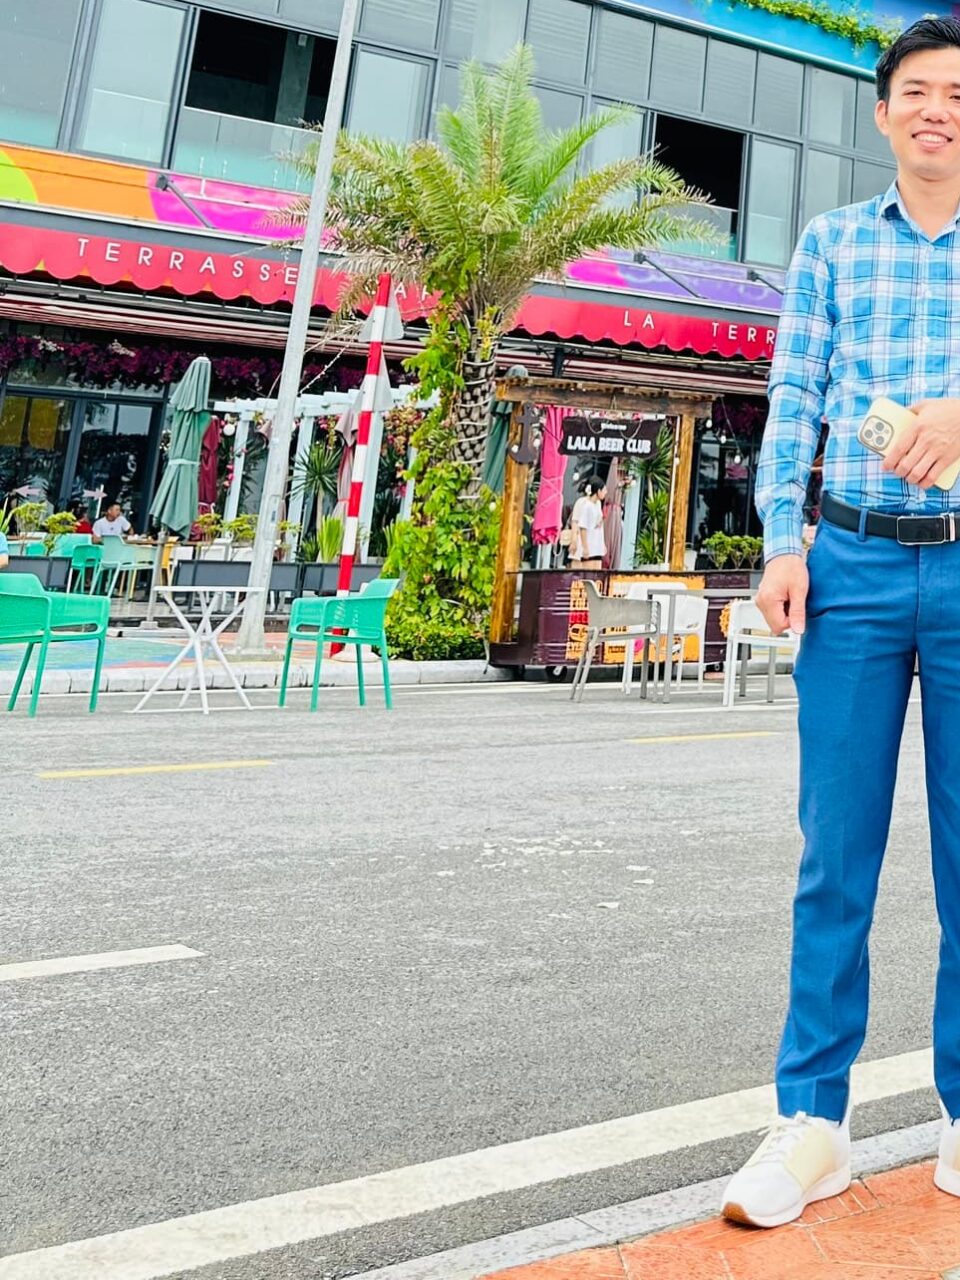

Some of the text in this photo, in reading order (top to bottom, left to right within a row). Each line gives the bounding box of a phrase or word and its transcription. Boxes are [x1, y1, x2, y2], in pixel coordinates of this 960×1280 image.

[77, 238, 298, 286] TERRASSE
[624, 310, 775, 345] LA TERR
[567, 436, 651, 454] LALA BEER CLUB
